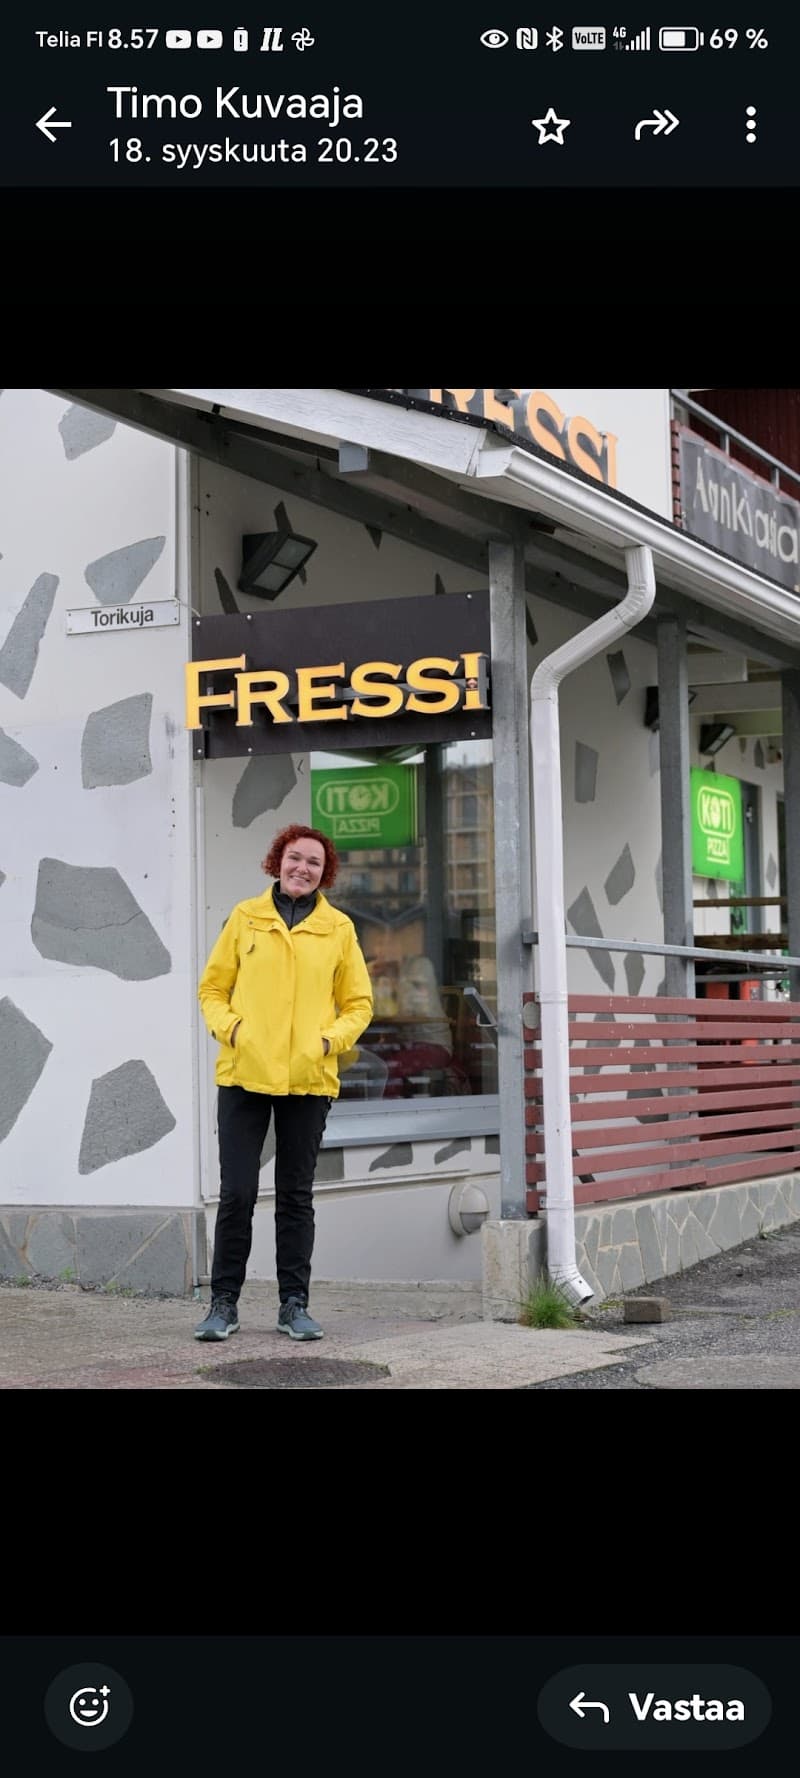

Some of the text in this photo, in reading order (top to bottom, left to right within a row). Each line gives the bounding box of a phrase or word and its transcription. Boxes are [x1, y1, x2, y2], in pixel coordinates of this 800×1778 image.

[90, 606, 154, 630] Torikuja
[184, 652, 488, 730] FRESSI
[702, 794, 732, 831] KOTI
[707, 838, 729, 857] PIZZA
